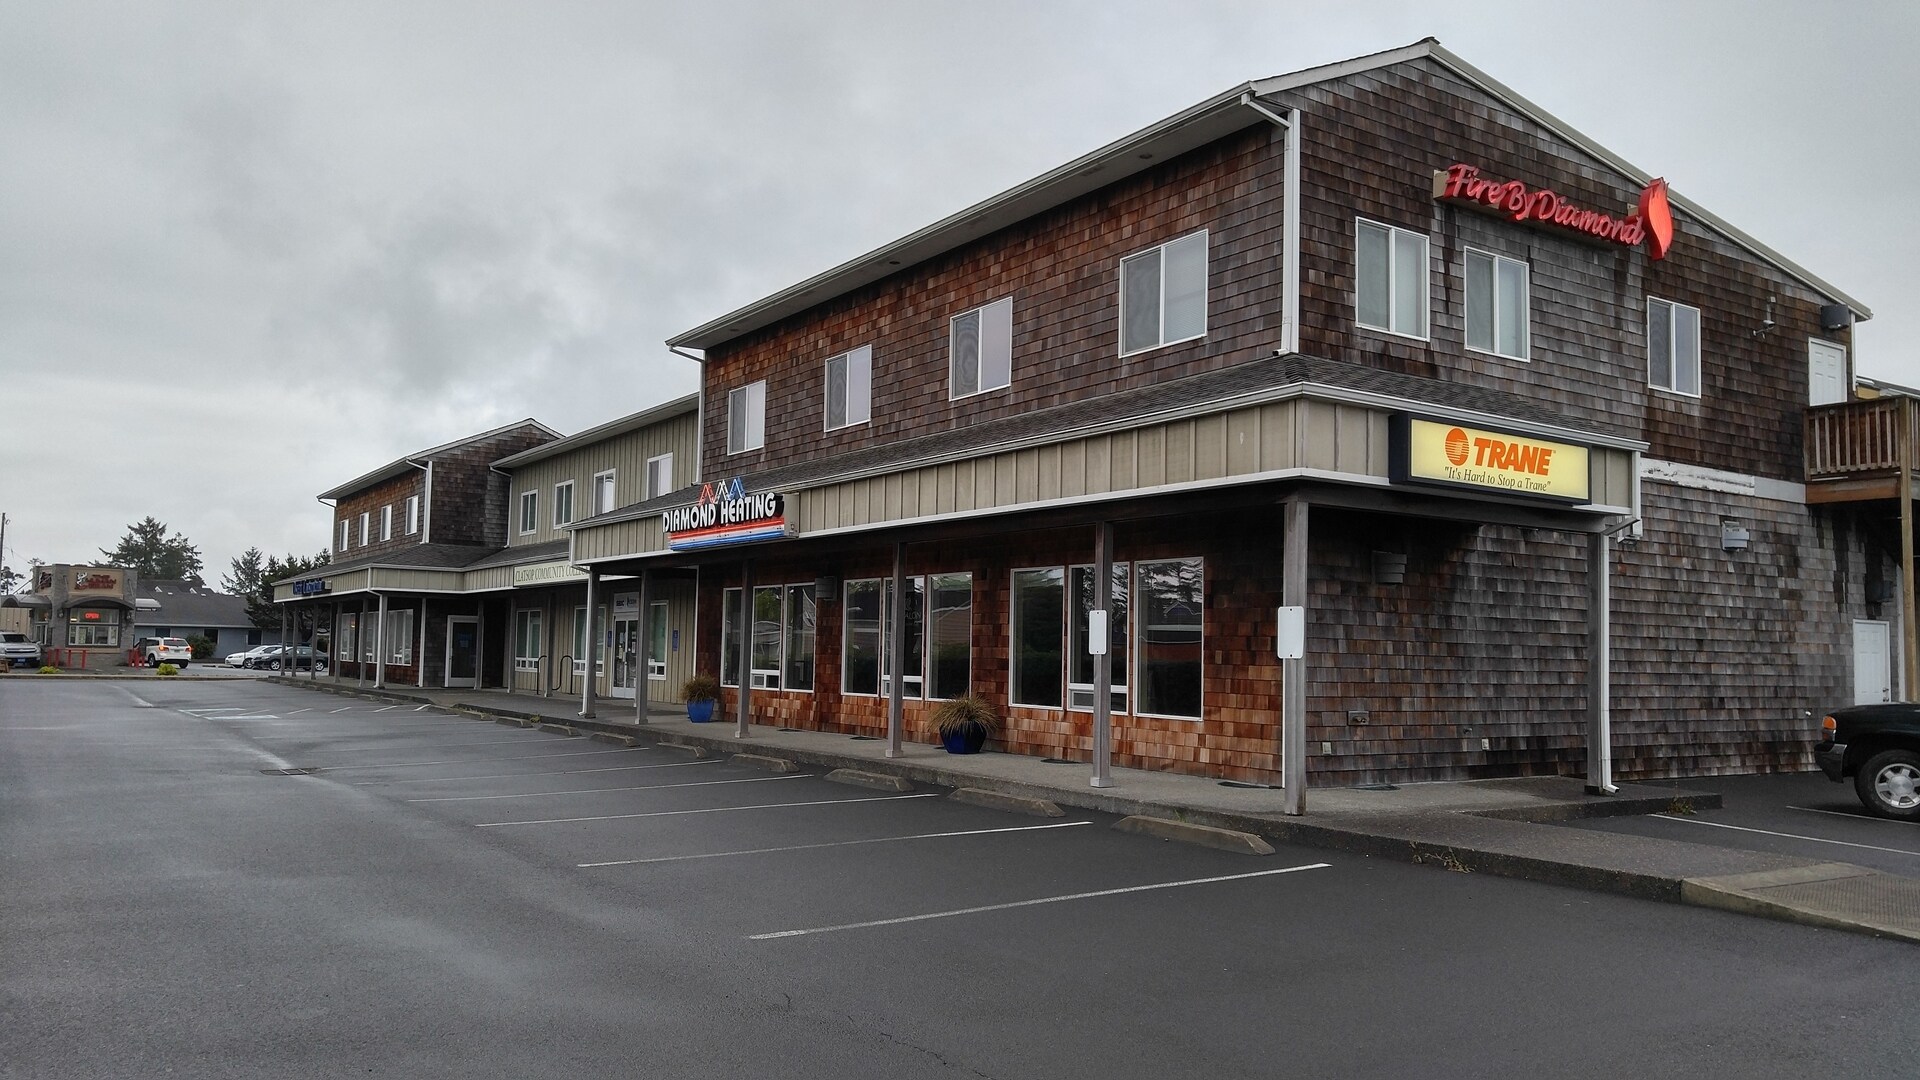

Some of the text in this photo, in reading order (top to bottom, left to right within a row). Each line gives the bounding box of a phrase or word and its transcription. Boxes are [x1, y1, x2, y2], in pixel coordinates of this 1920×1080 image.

[1448, 163, 1646, 246] Fire By Diamond
[1473, 437, 1553, 476] TRANE
[1444, 466, 1551, 491] "It's Hard to Stop a Trane"
[662, 492, 777, 533] DIAMOND HEATING
[515, 568, 534, 582] CLATSOP
[534, 565, 565, 581] COMMUNITY
